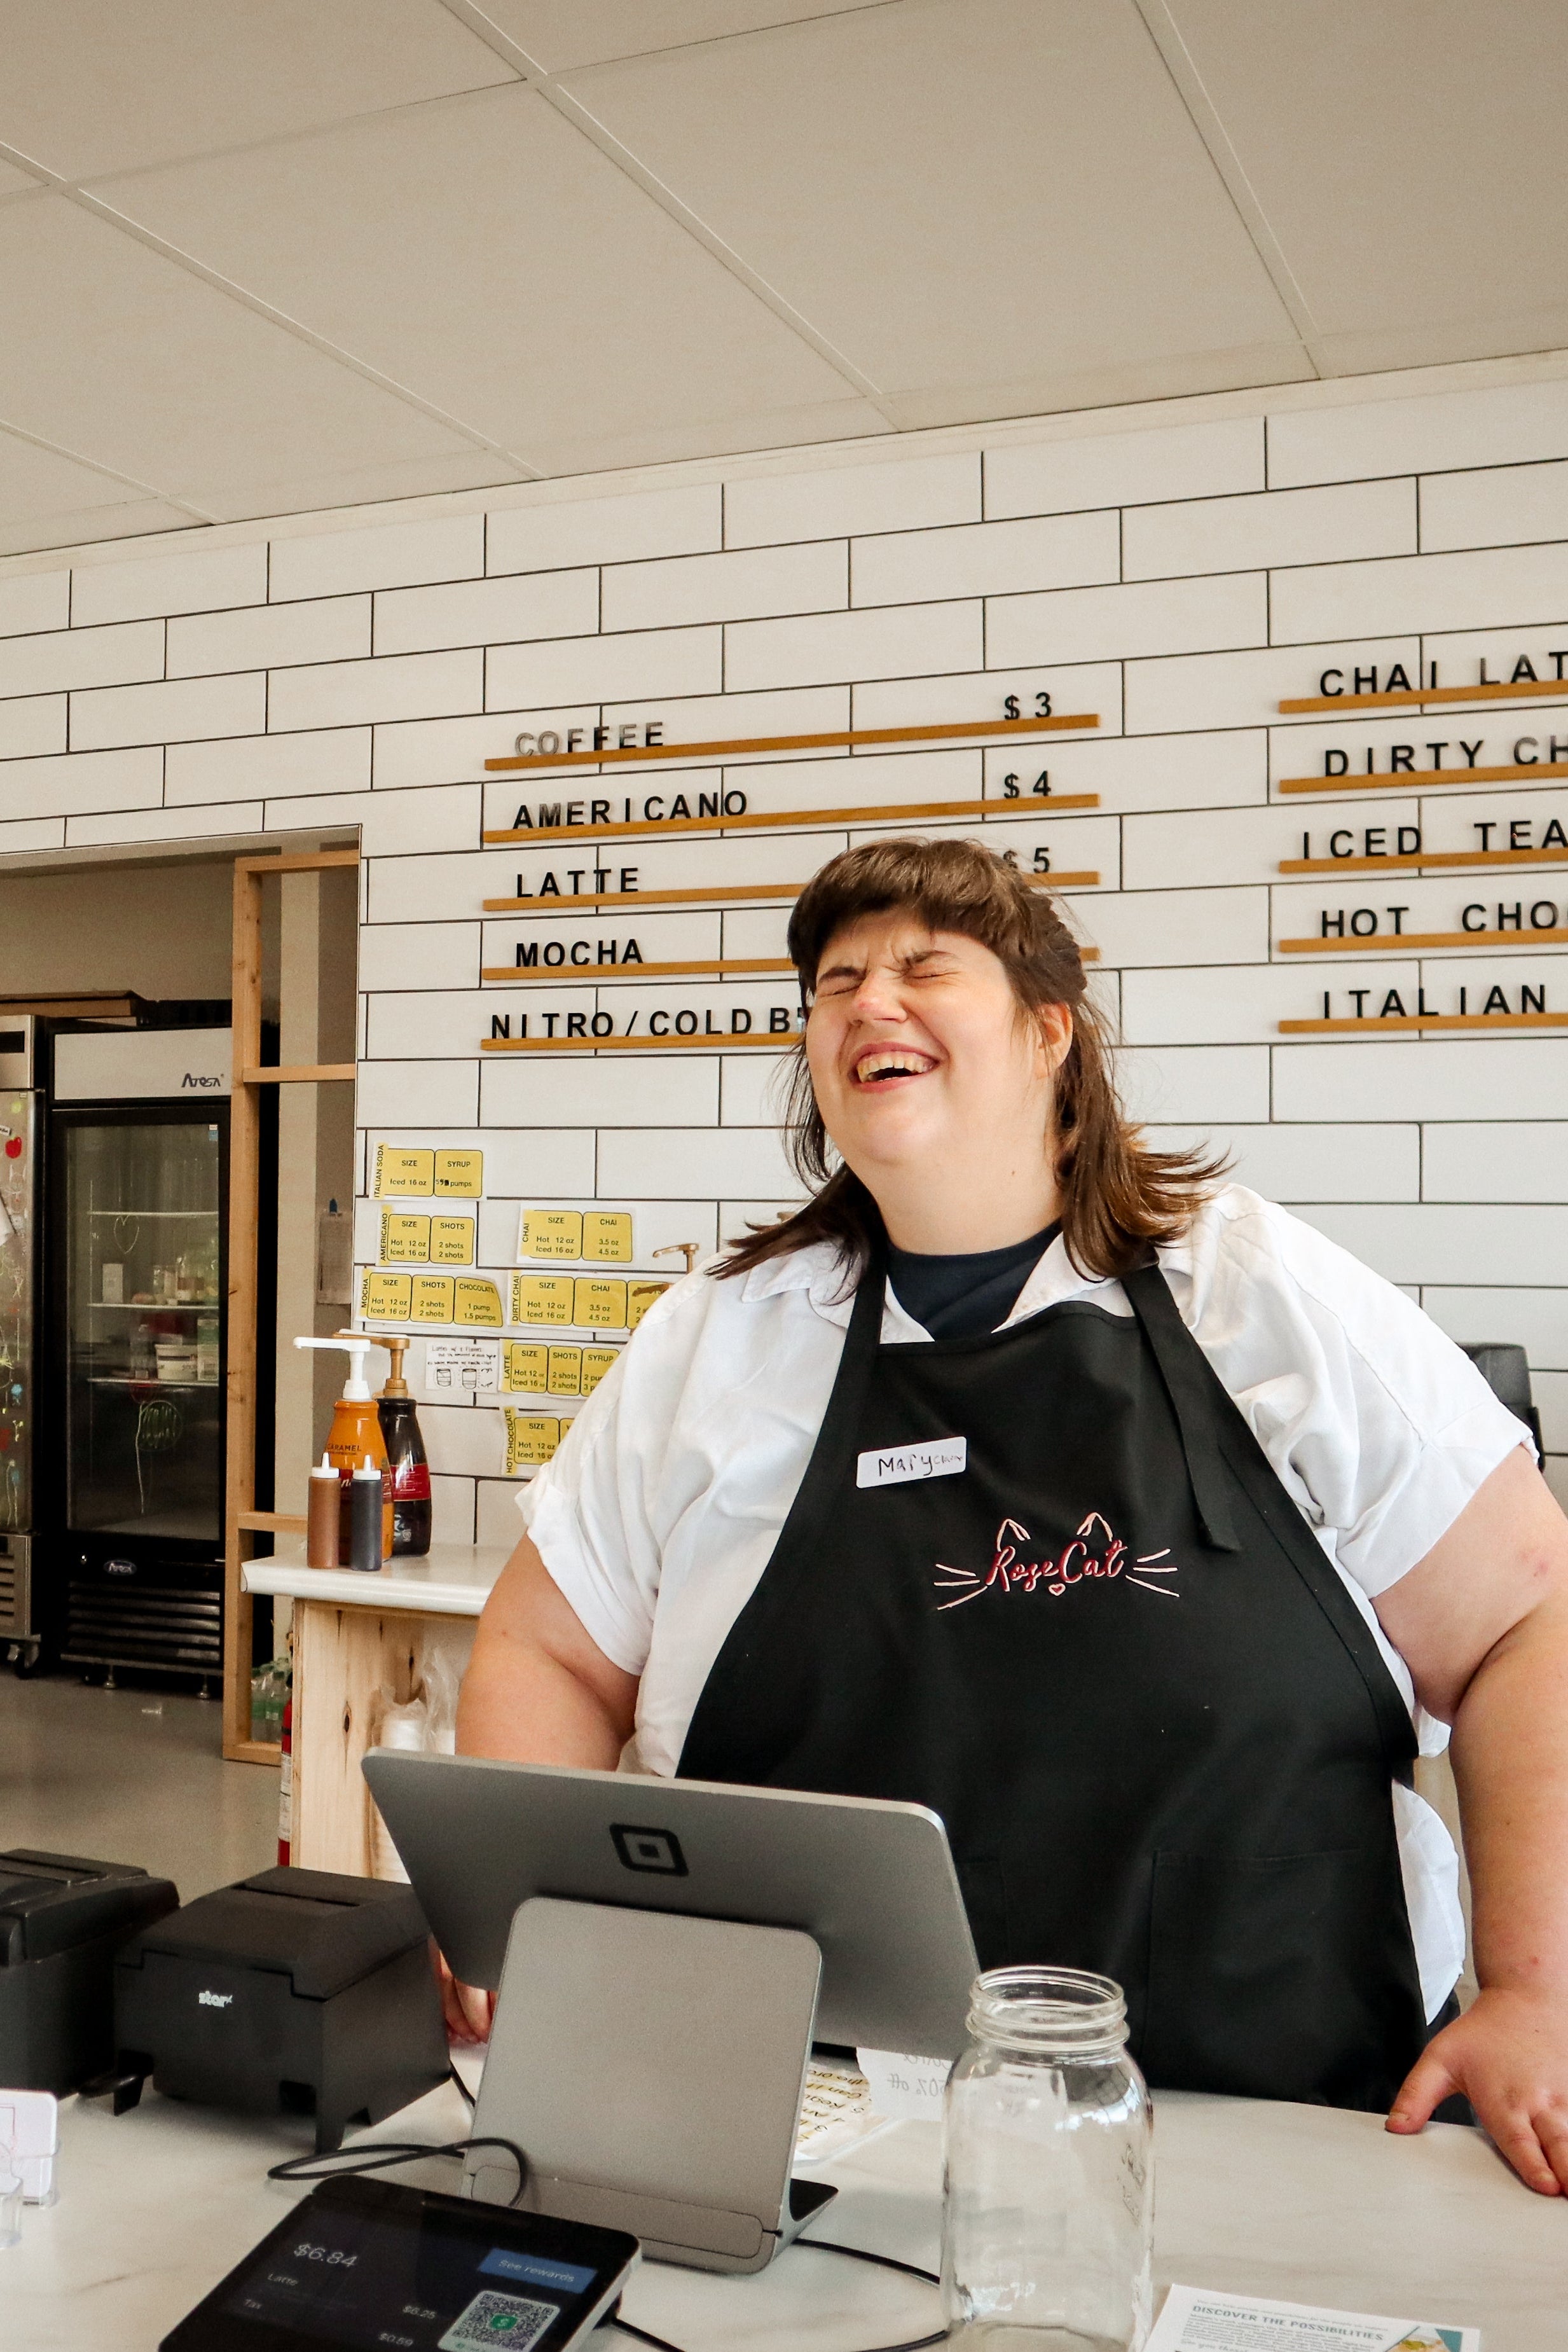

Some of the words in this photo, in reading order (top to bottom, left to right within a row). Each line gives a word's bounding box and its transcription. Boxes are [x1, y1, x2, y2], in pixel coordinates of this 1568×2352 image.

[1320, 661, 1438, 696] CHAI
[515, 721, 664, 757] COFFEE
[1325, 740, 1483, 777] DIRTY
[512, 790, 747, 829] AMERICANO
[1303, 826, 1422, 859] ICED
[1474, 819, 1568, 852] TEA
[517, 868, 638, 898] LATTE
[1321, 906, 1409, 937] HOT
[1462, 901, 1568, 932] CHO
[516, 939, 643, 967] MOCHA
[1324, 985, 1546, 1019] ITALIAN
[374, 1168, 382, 1198] ITALIAN
[459, 1283, 495, 1294] CHOCOLATE
[505, 1409, 514, 1454] CHOCOLATE
[294, 2243, 358, 2267] $6.84
[499, 2260, 522, 2271] See
[525, 2266, 575, 2283] rewards
[268, 2273, 298, 2286] Latte
[1193, 2305, 1257, 2321] DISCOVER
[1263, 2316, 1285, 2326] THE
[1290, 2321, 1384, 2341] POSSIBILITIES
